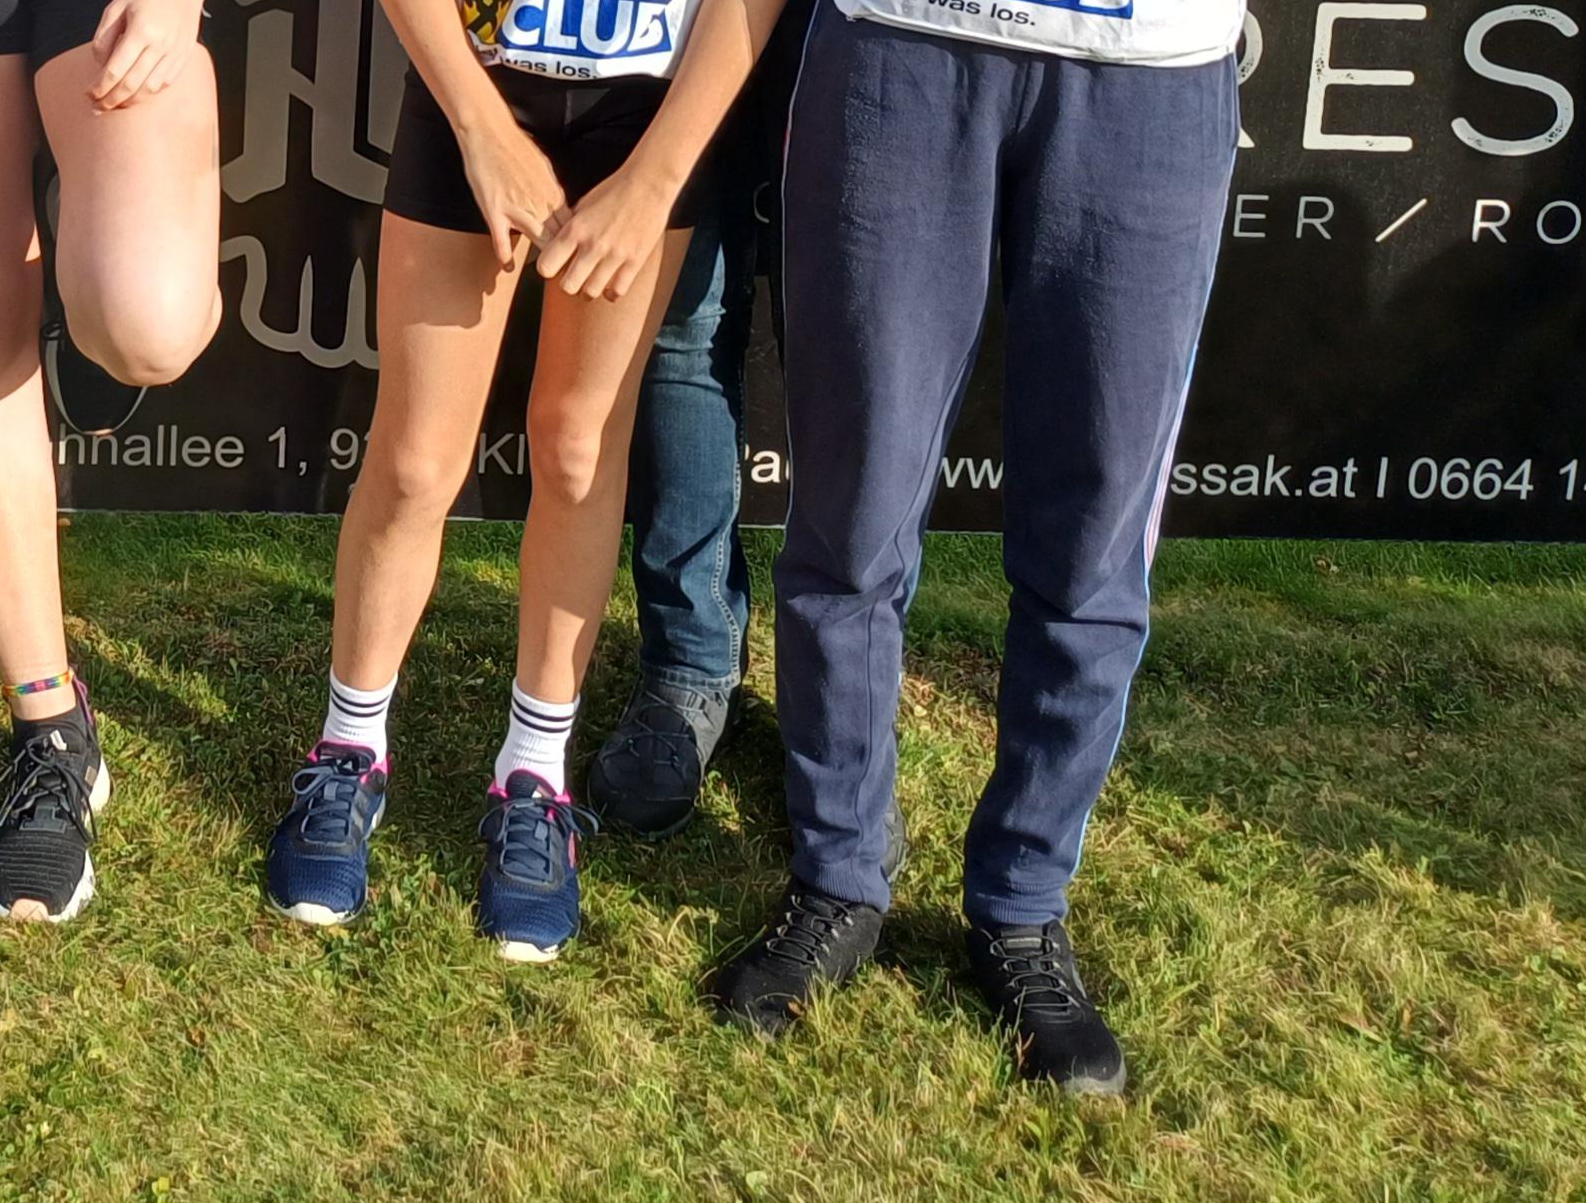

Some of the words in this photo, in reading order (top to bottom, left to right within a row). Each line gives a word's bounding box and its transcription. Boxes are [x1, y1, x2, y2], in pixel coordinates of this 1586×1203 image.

[991, 3, 1036, 26] los.
[268, 426, 308, 475] 1,
[1408, 456, 1534, 501] 0664
